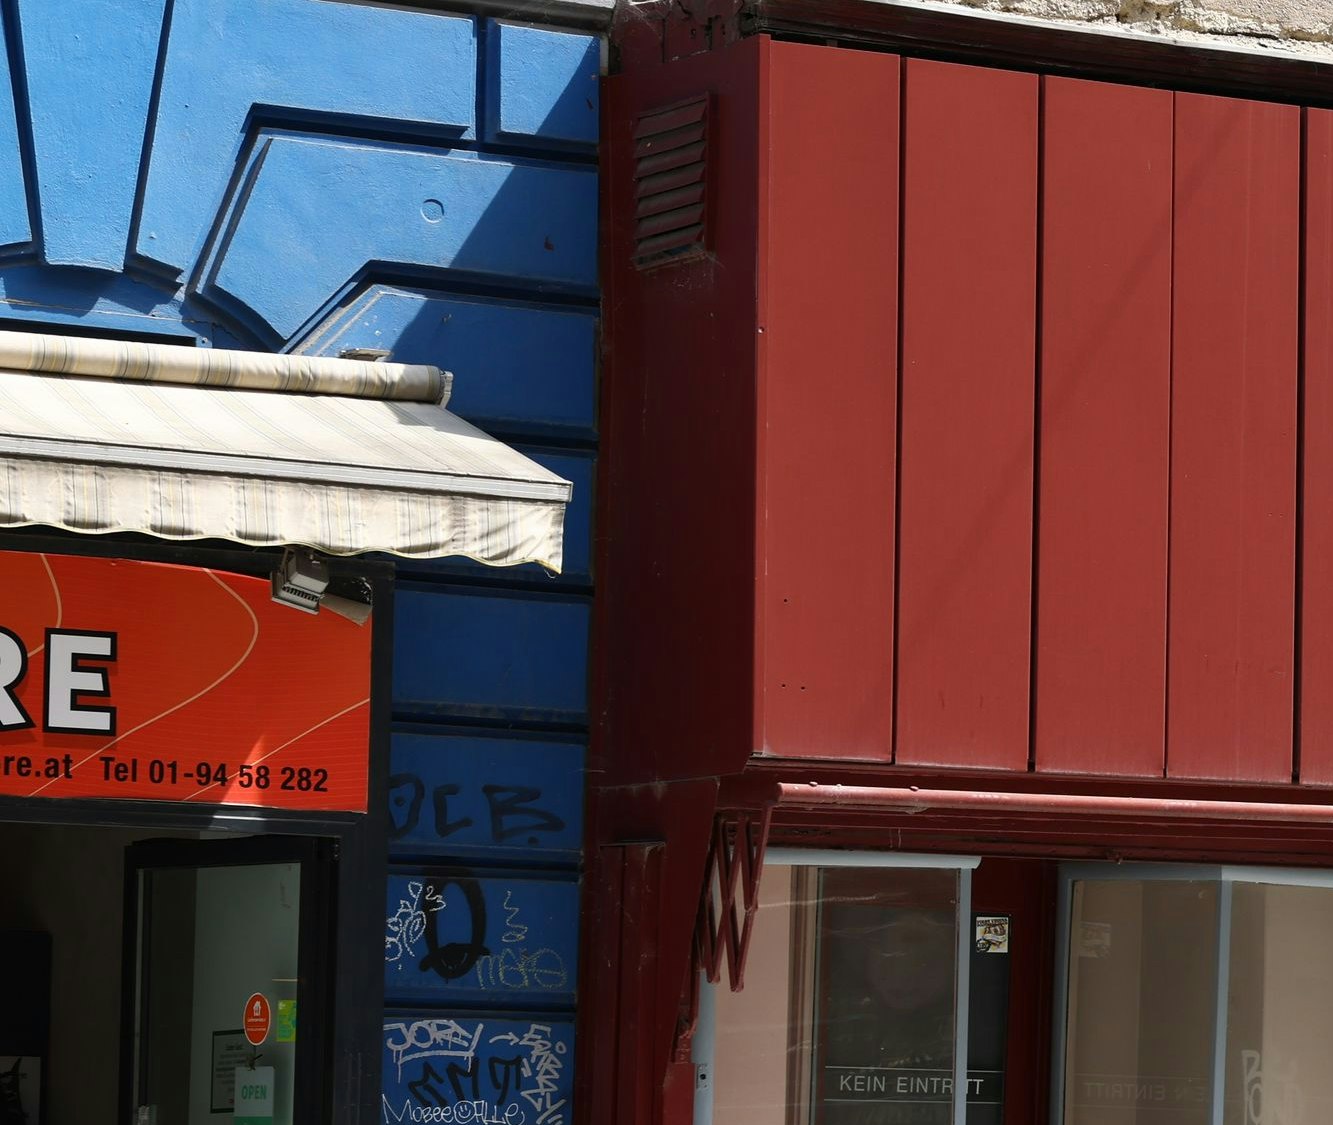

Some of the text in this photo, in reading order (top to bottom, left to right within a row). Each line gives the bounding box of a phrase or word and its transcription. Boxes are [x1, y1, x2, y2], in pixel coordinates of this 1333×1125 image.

[100, 756, 138, 783] Tel
[149, 759, 229, 787] 01-94
[238, 764, 271, 790] 58
[280, 766, 329, 793] 282
[241, 1084, 267, 1100] OPEN
[839, 1074, 985, 1095] KEIN EINTRTT
